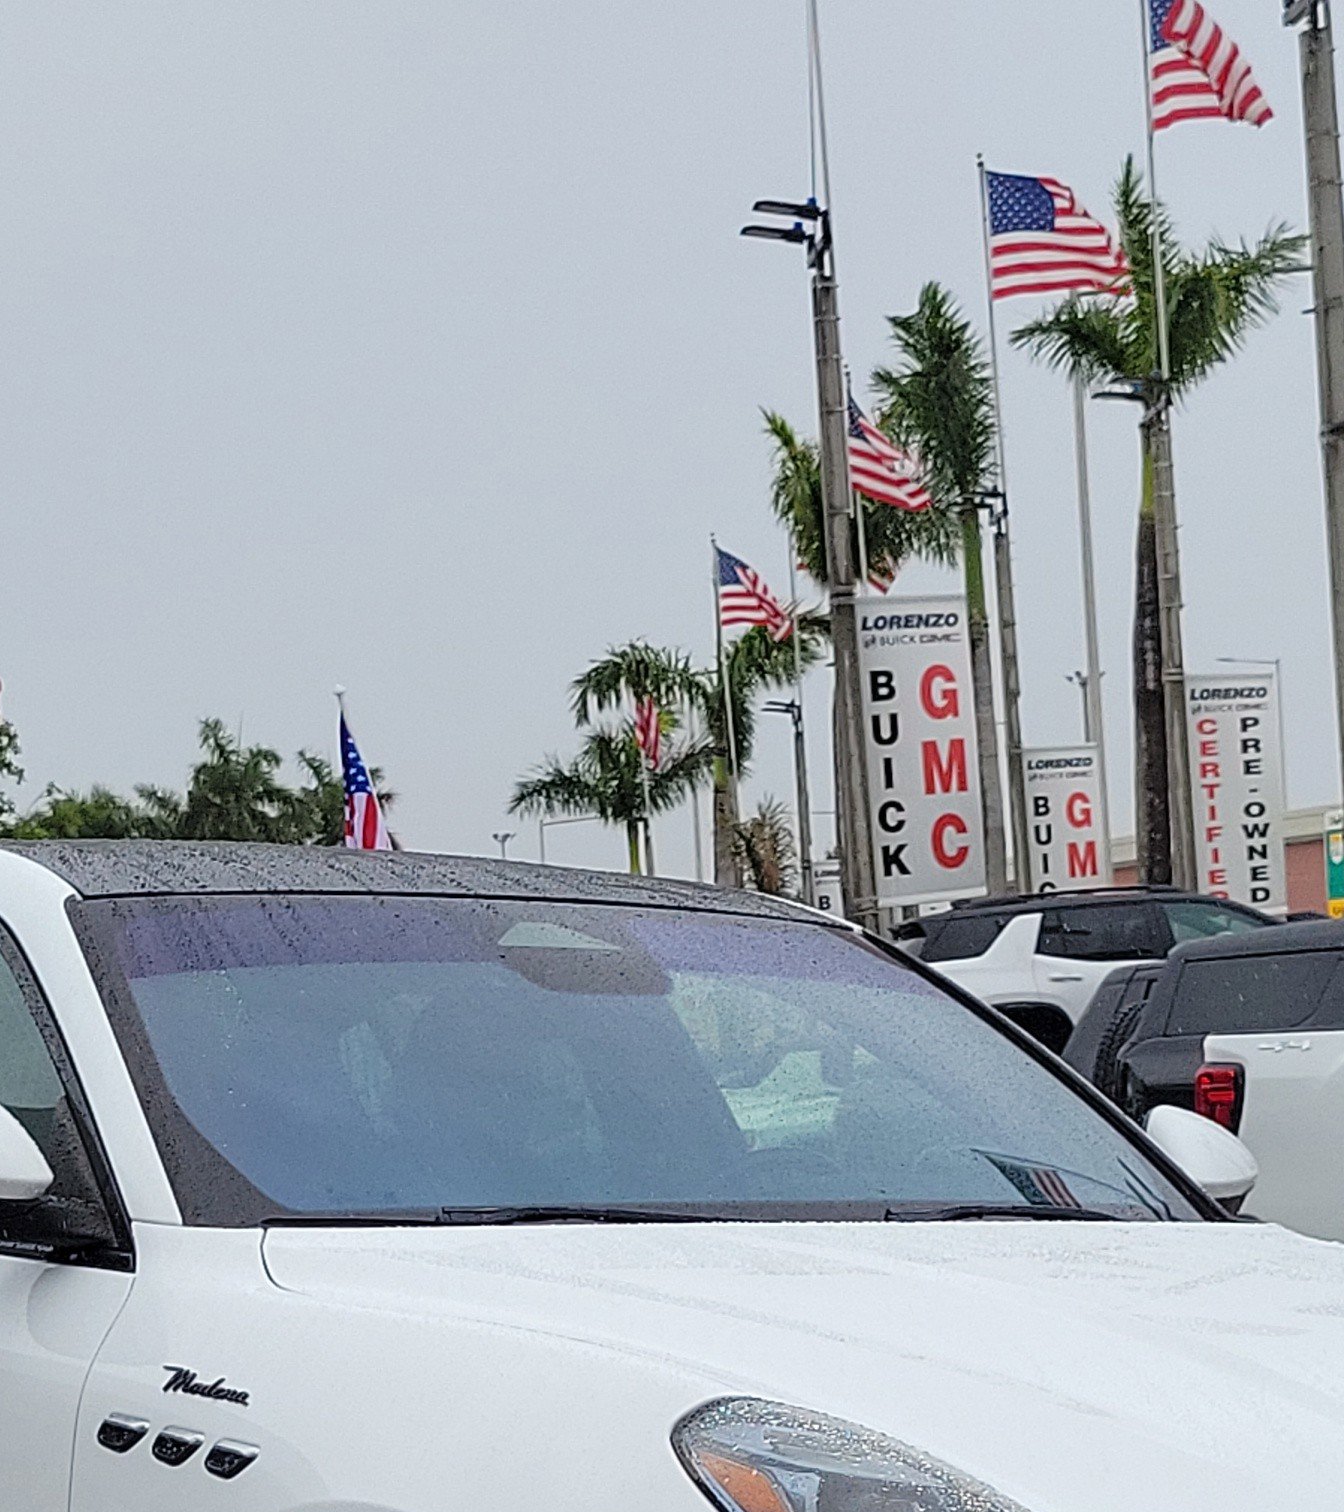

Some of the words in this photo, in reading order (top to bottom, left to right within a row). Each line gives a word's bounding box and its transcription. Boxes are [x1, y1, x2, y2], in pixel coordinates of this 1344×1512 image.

[861, 613, 959, 631] LORENZO
[880, 635, 917, 647] BUICK
[1190, 687, 1267, 700] LORENZO
[869, 670, 911, 877] BUICK
[920, 664, 970, 869] GMC
[1241, 717, 1269, 903] PRE-OWNED
[162, 1365, 250, 1407] Modena
